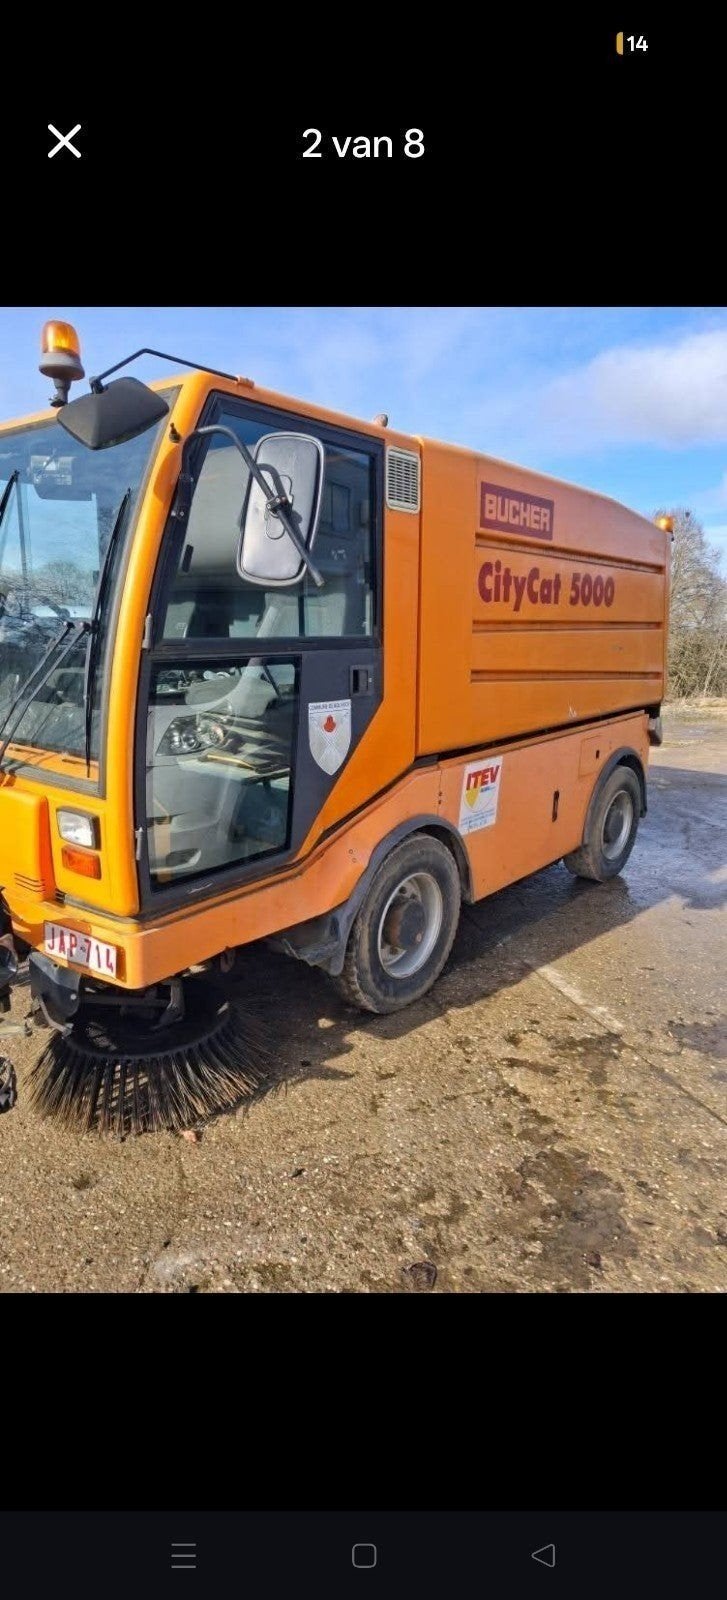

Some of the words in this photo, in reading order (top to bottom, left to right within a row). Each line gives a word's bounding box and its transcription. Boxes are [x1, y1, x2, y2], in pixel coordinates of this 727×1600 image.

[484, 494, 551, 532] BUCHER
[478, 559, 562, 612] CityCat
[569, 572, 615, 608] 5000
[466, 765, 501, 791] ITEV
